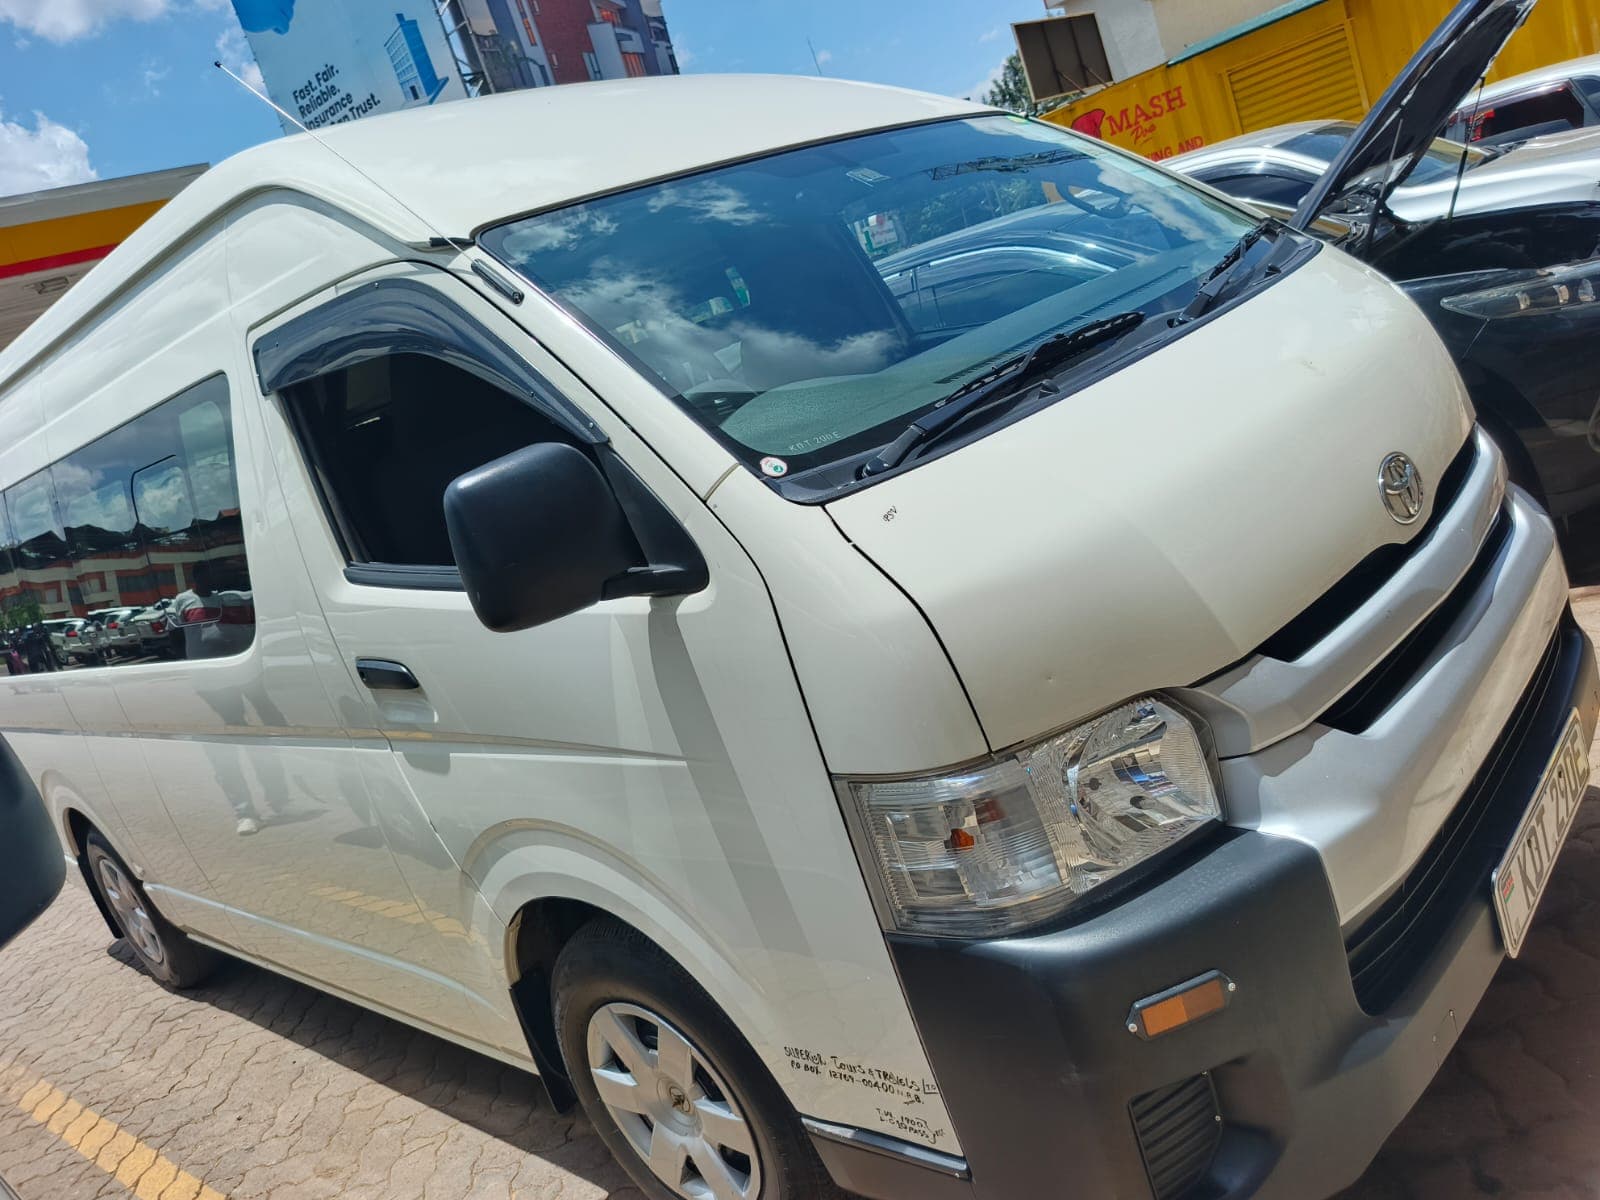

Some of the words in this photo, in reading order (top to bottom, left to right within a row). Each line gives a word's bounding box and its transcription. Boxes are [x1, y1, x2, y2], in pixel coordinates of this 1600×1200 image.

[293, 79, 317, 104] Fast.
[315, 63, 339, 88] Fair.
[298, 85, 341, 119] Reliable.
[349, 93, 381, 121] Trust.
[1106, 85, 1187, 136] MASH
[1178, 135, 1204, 154] AND
[1550, 728, 1586, 838] 290E
